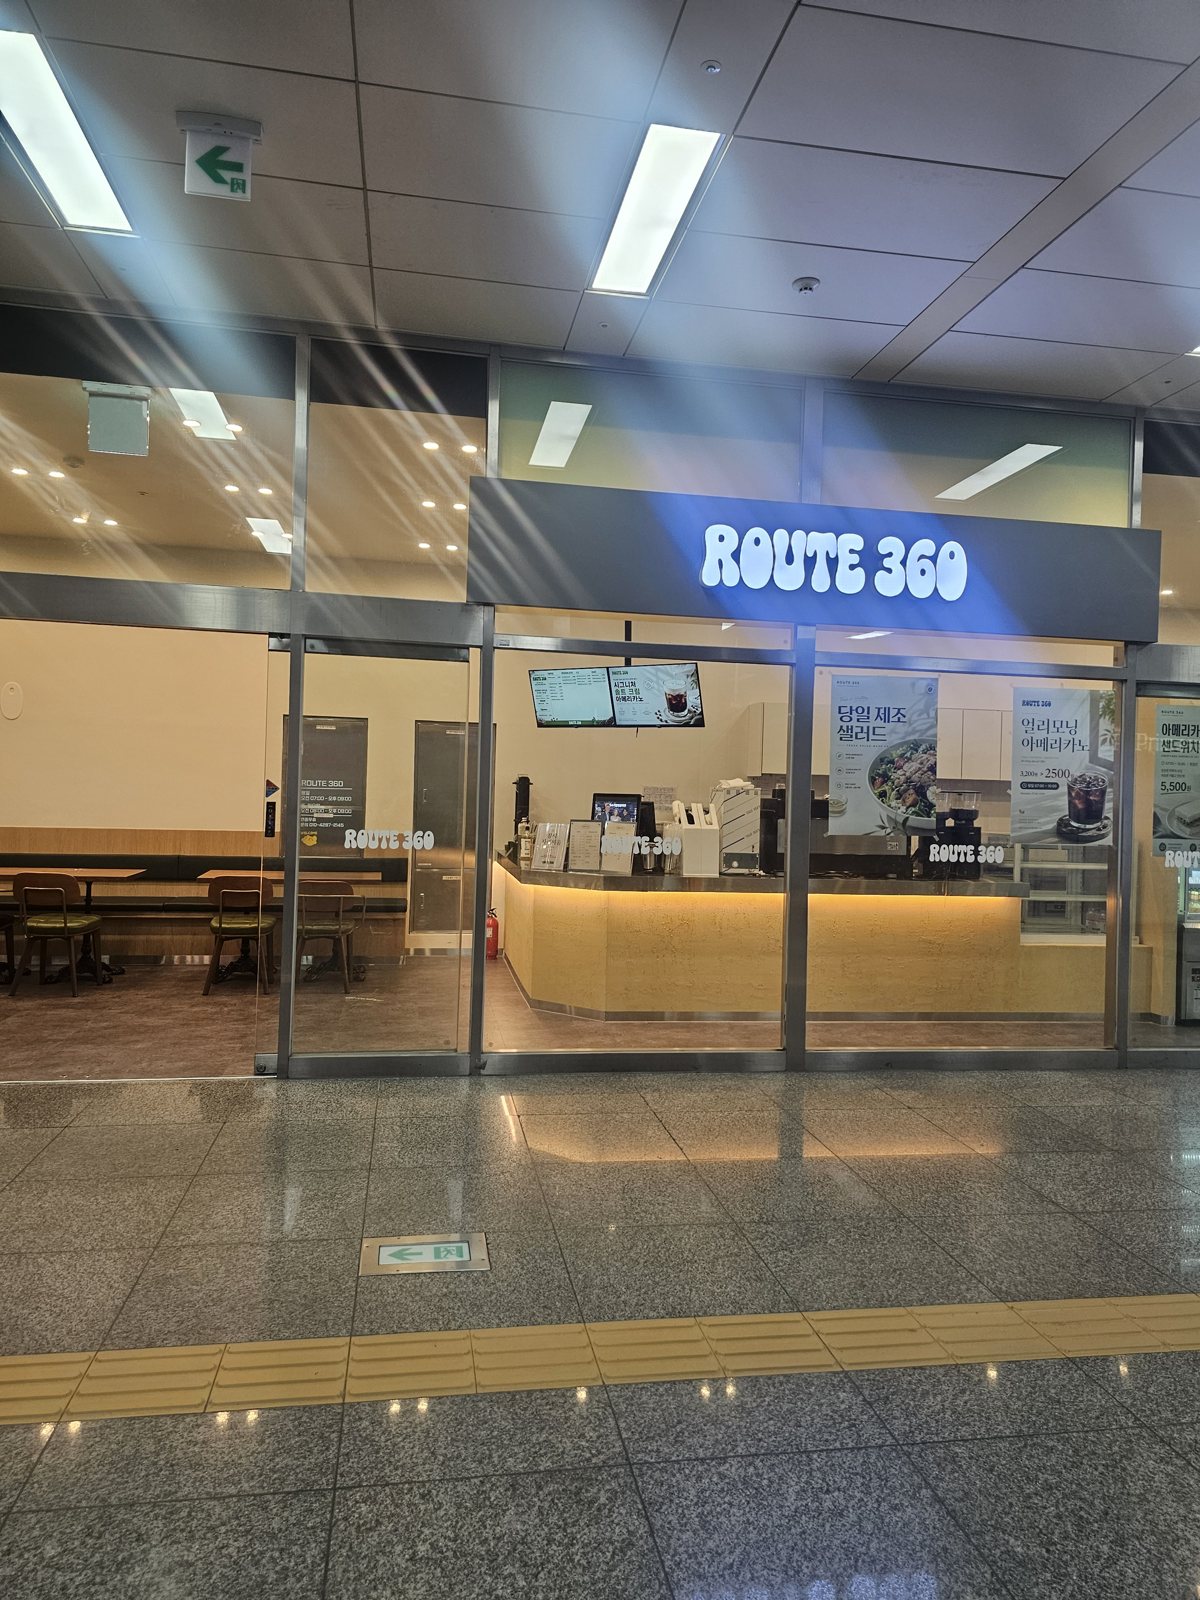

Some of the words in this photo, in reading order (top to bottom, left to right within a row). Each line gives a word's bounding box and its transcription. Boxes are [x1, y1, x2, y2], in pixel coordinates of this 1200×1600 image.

[701, 524, 866, 595] ROUTE
[874, 536, 968, 602] 360
[837, 705, 871, 723] 당일
[874, 706, 907, 724] 제조
[837, 725, 887, 742] 샐러드
[1021, 717, 1078, 736] 얼리모닝
[1021, 736, 1090, 753] 아메리카노
[1161, 739, 1200, 754] 샌드위치
[344, 829, 400, 850] ROUTE
[402, 830, 435, 850] 360
[652, 836, 682, 856] 360
[928, 844, 975, 863] ROUTE
[976, 846, 1004, 864] 360
